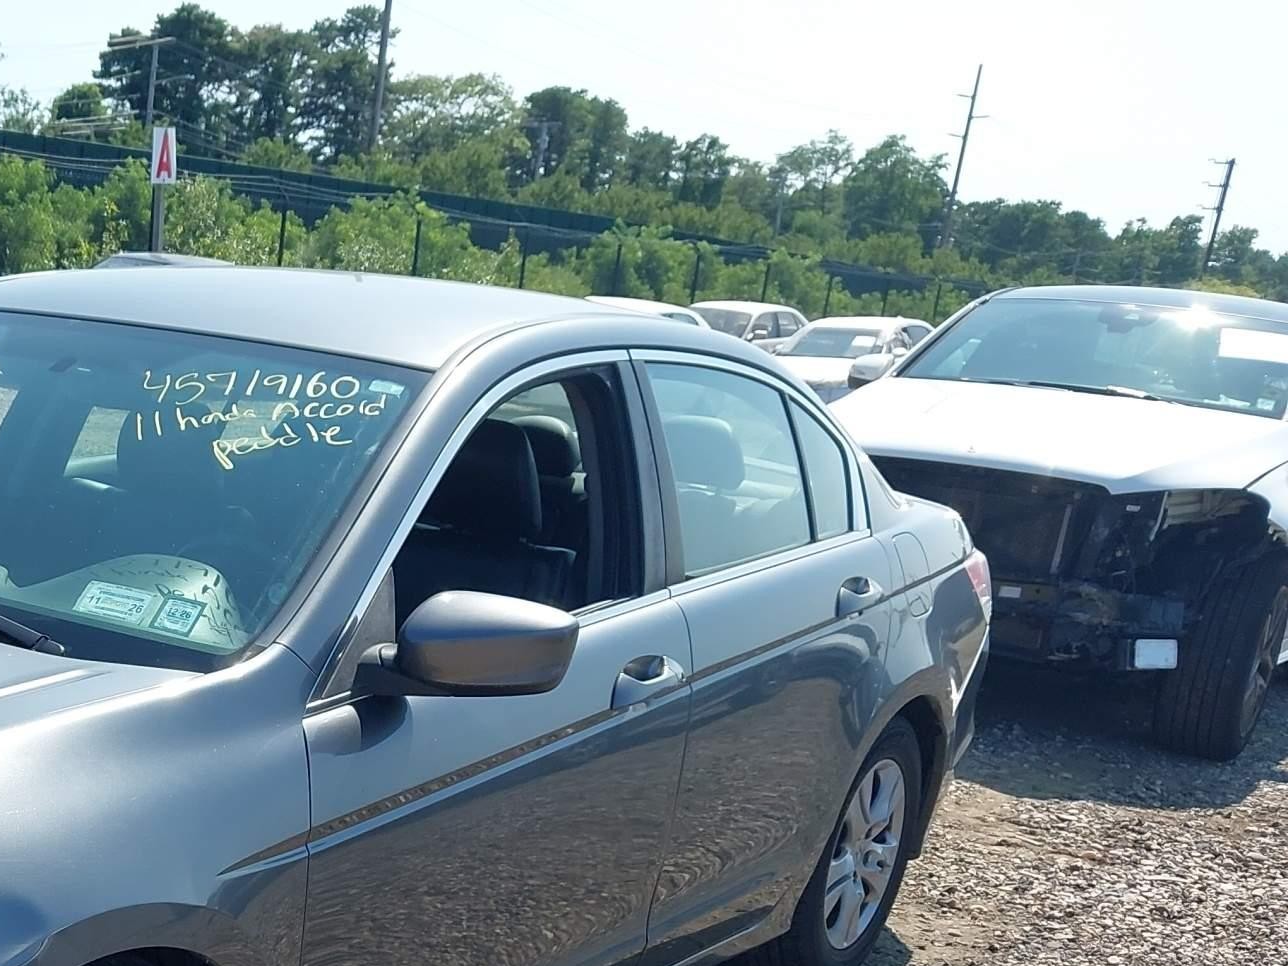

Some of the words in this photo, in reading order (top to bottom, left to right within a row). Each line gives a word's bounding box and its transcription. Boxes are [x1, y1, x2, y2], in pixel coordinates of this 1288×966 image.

[155, 129, 172, 178] A
[142, 369, 360, 405] 45719160
[136, 411, 162, 440] 11
[86, 594, 101, 605] 11
[128, 603, 143, 614] 26
